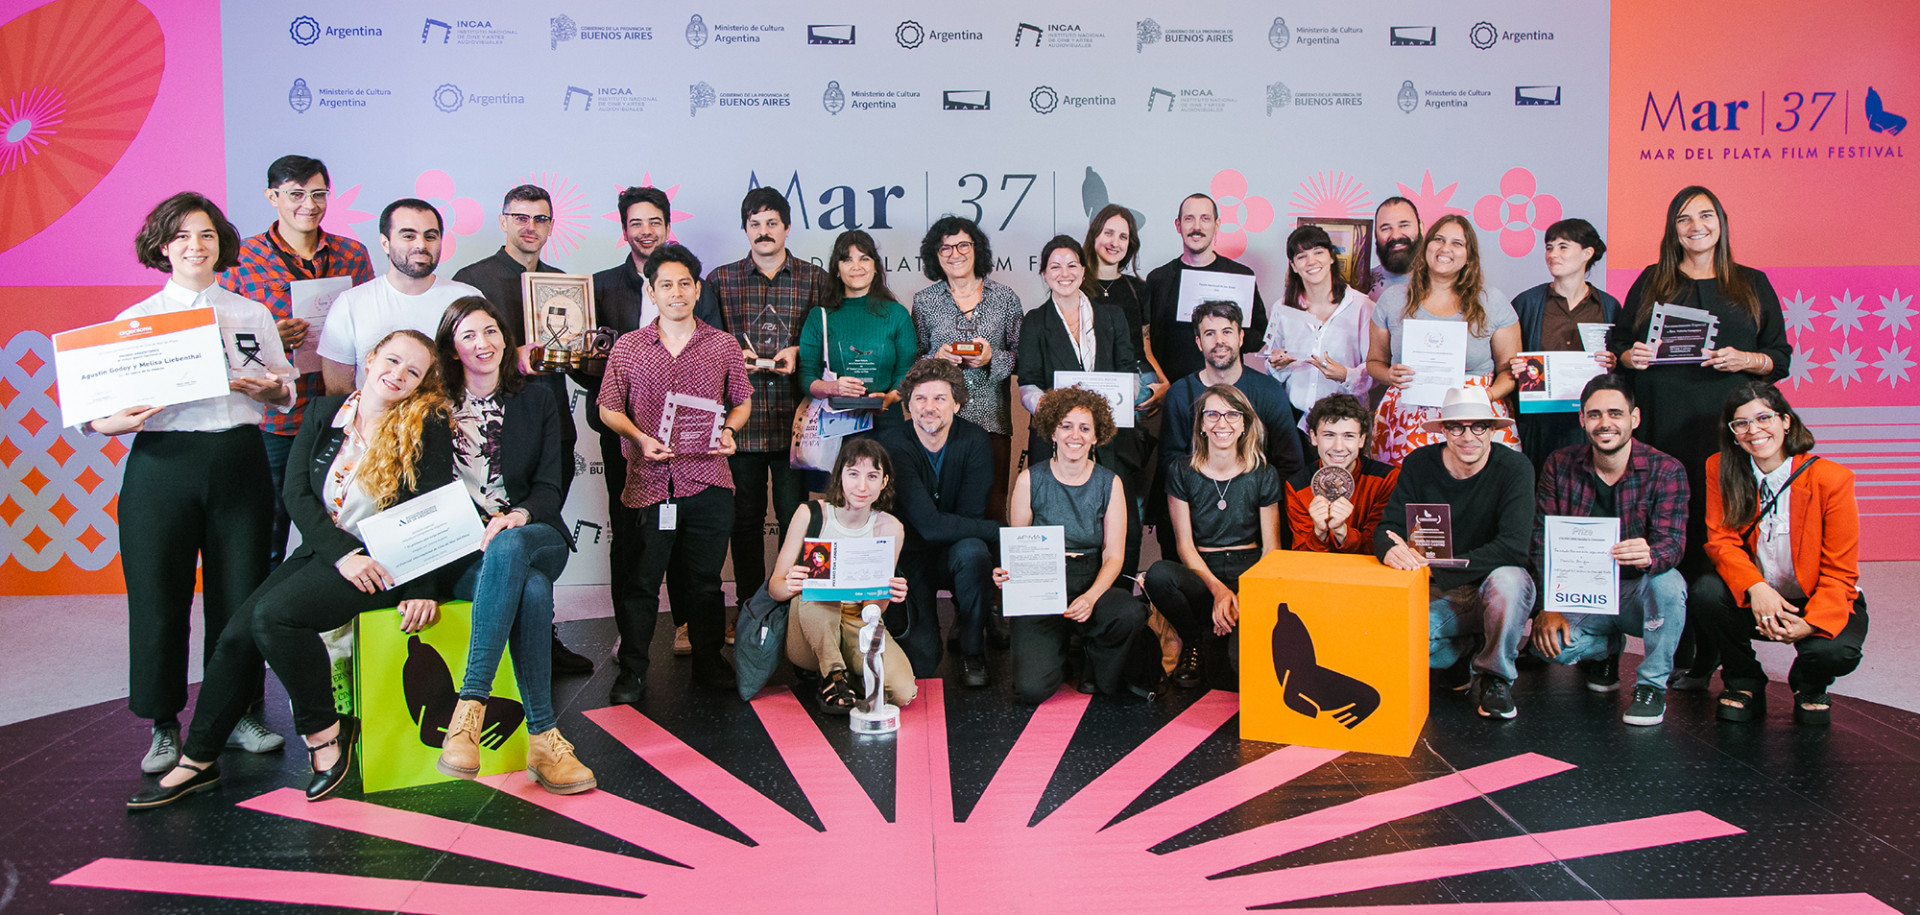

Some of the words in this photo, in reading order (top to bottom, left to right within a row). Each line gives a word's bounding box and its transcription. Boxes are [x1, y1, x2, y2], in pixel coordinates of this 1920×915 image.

[325, 26, 383, 38] Argentina
[581, 32, 621, 40] BUENOS
[624, 32, 652, 40] AIRES
[929, 29, 983, 42] Argentina
[1165, 34, 1204, 42] BUENOS
[1207, 34, 1233, 42] AIRES
[1502, 30, 1554, 43] Argentina
[714, 34, 760, 44] Argentina
[1296, 36, 1340, 46] Argentina
[319, 98, 366, 108] Argentina
[468, 93, 525, 106] Argentina
[720, 98, 759, 106] BUENOS
[763, 98, 790, 106] AIRES
[851, 100, 896, 110] Argentina
[1063, 95, 1116, 108] Argentina
[1424, 99, 1468, 109] Argentina
[1641, 90, 1749, 132] Mar
[1776, 91, 1837, 132] 37
[1640, 148, 1676, 160] MAR
[1685, 148, 1713, 160] DEL
[1724, 147, 1772, 160] PLATA
[1782, 147, 1818, 159] FILM
[1828, 146, 1905, 158] FESTIVAL
[958, 173, 1038, 232] 37
[109, 364, 132, 375] Godoy
[138, 358, 163, 369] Melisa
[164, 353, 202, 365] Liebenthal
[1555, 592, 1607, 605] SIGNIS
